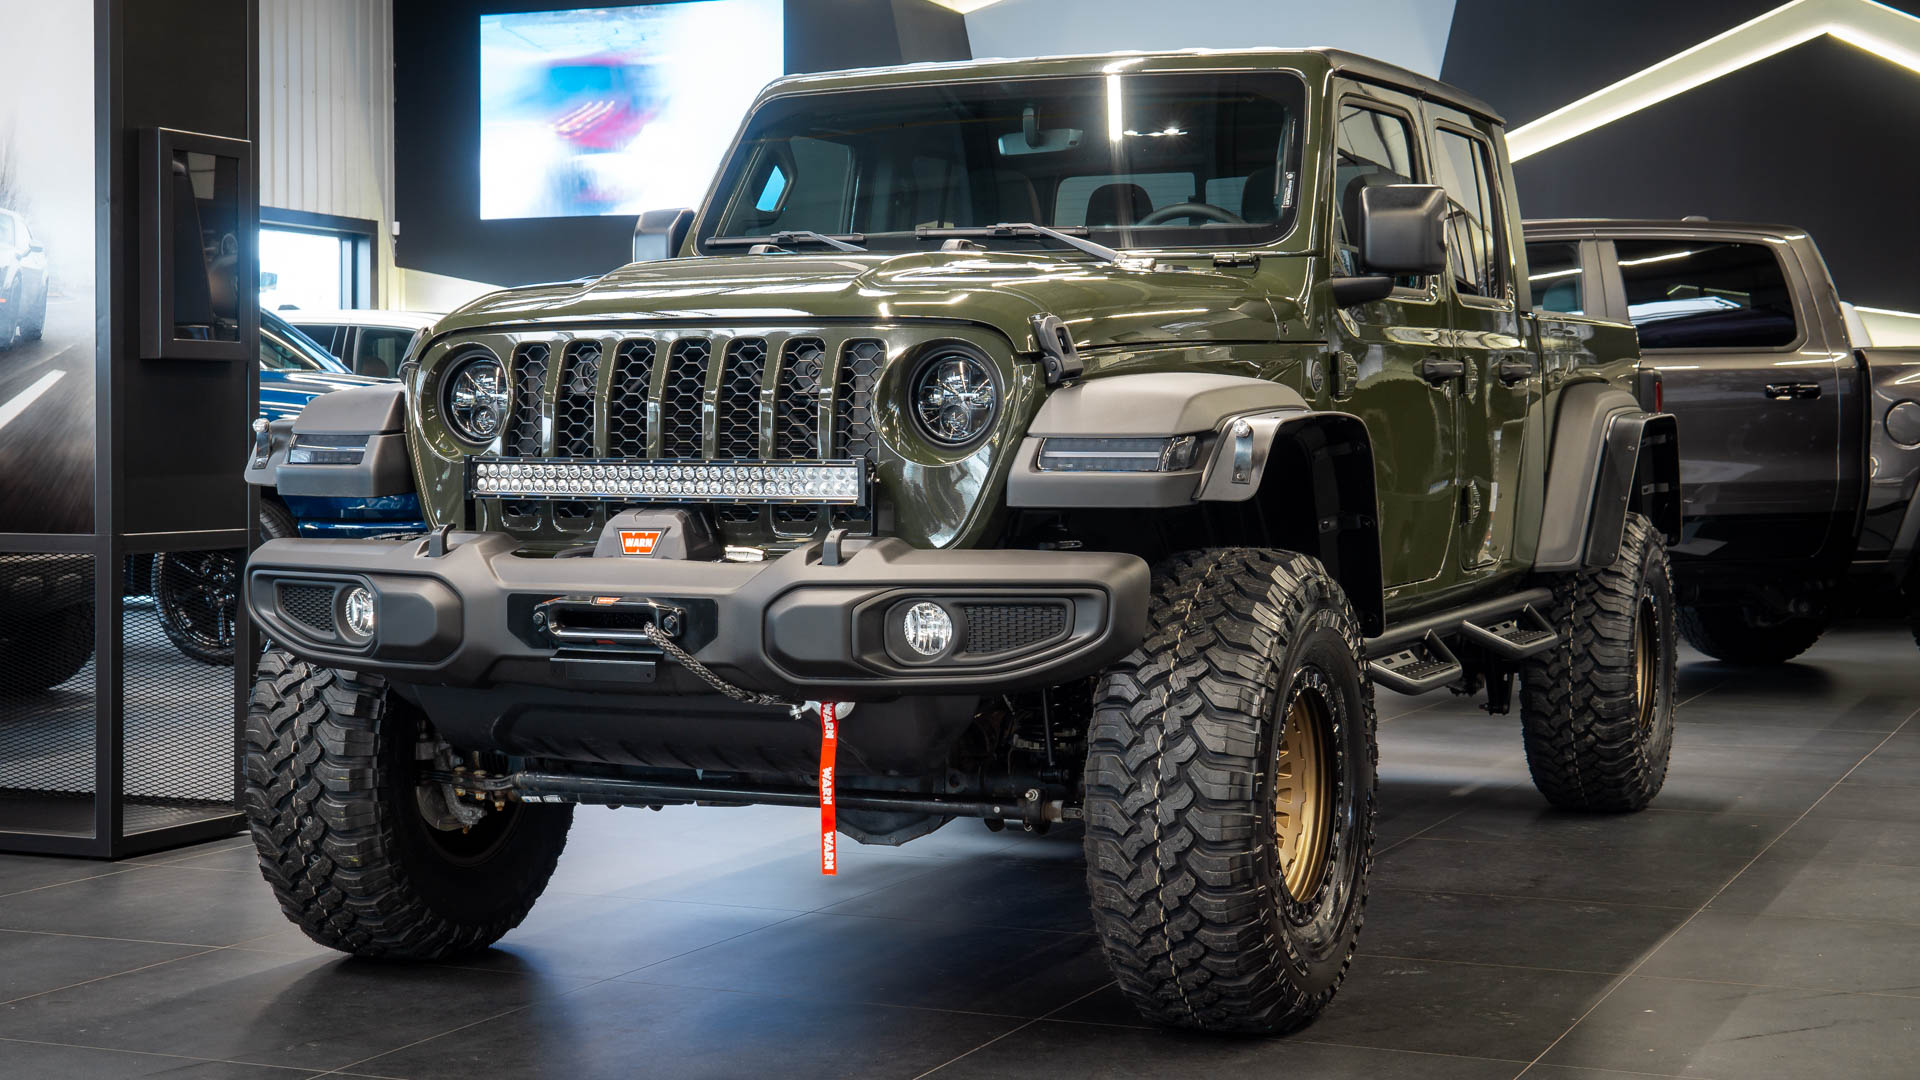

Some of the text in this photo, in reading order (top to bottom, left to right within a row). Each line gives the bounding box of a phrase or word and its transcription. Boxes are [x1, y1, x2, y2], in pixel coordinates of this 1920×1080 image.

[625, 538, 653, 547] WARN
[822, 703, 835, 739] WARN
[822, 766, 833, 805] WARN
[823, 831, 835, 870] WARN
